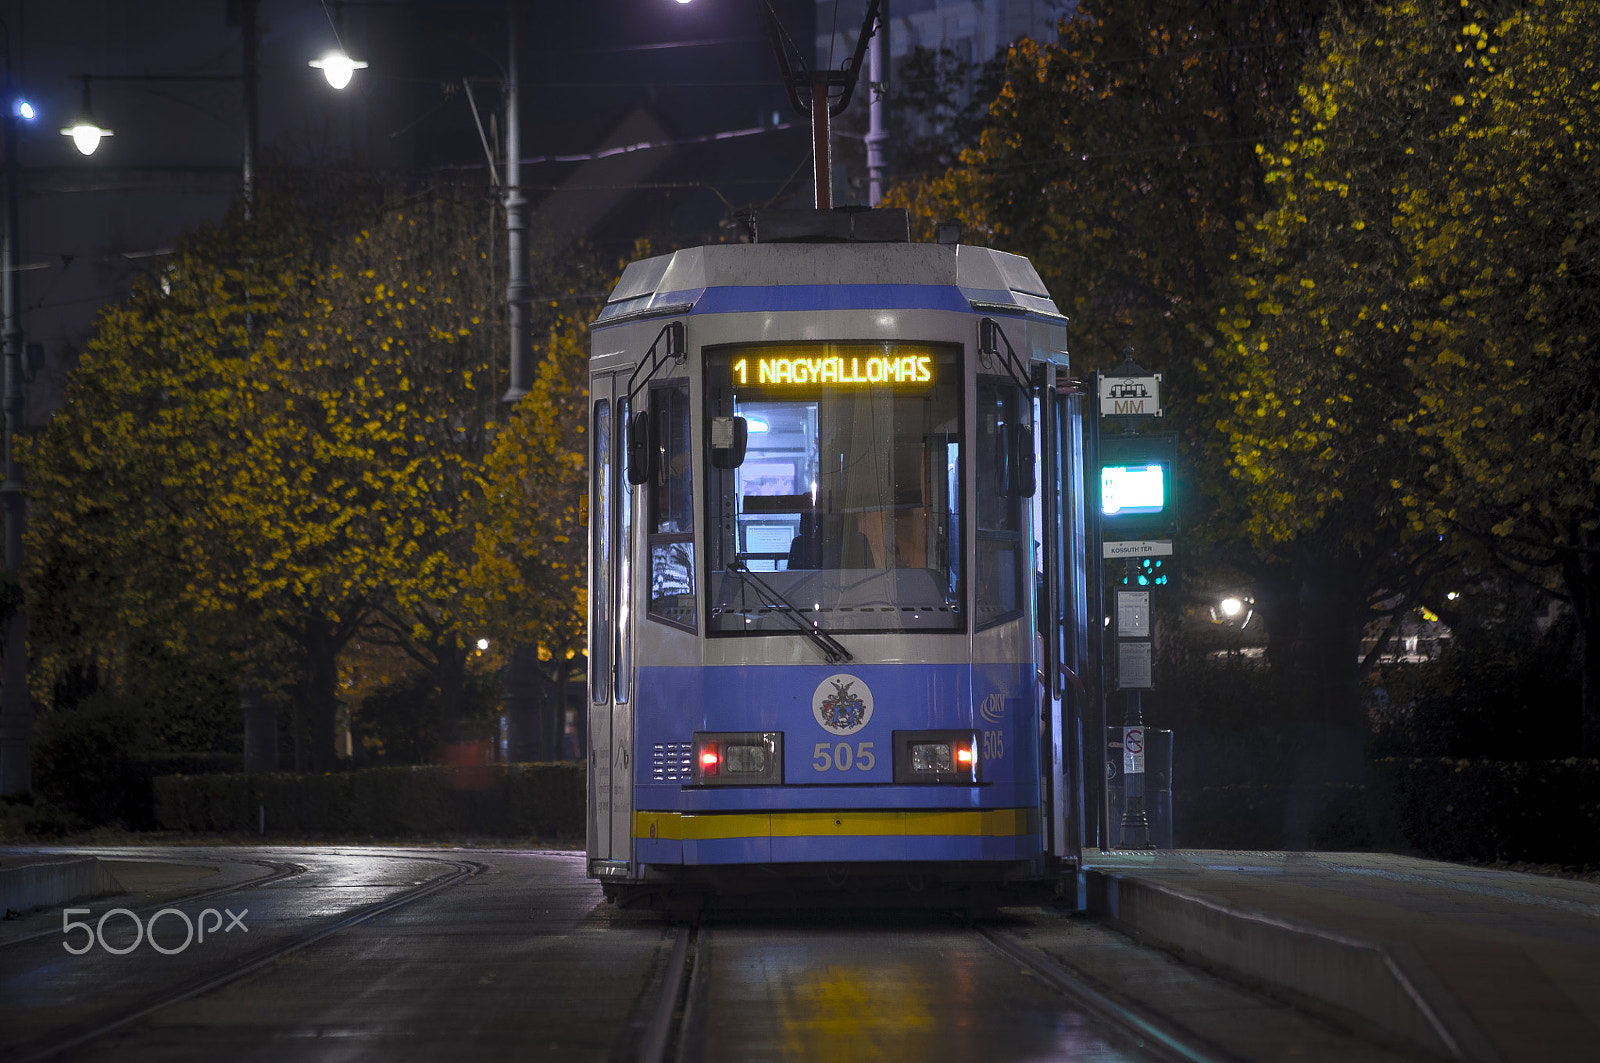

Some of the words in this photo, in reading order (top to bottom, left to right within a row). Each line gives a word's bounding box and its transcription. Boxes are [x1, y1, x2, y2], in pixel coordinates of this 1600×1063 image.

[733, 359, 747, 384] 1
[759, 356, 932, 384] NAGYÁLLOMÁS
[1114, 399, 1144, 414] MM
[988, 693, 1006, 713] DKV
[811, 741, 876, 772] 505
[983, 730, 1005, 761] 505
